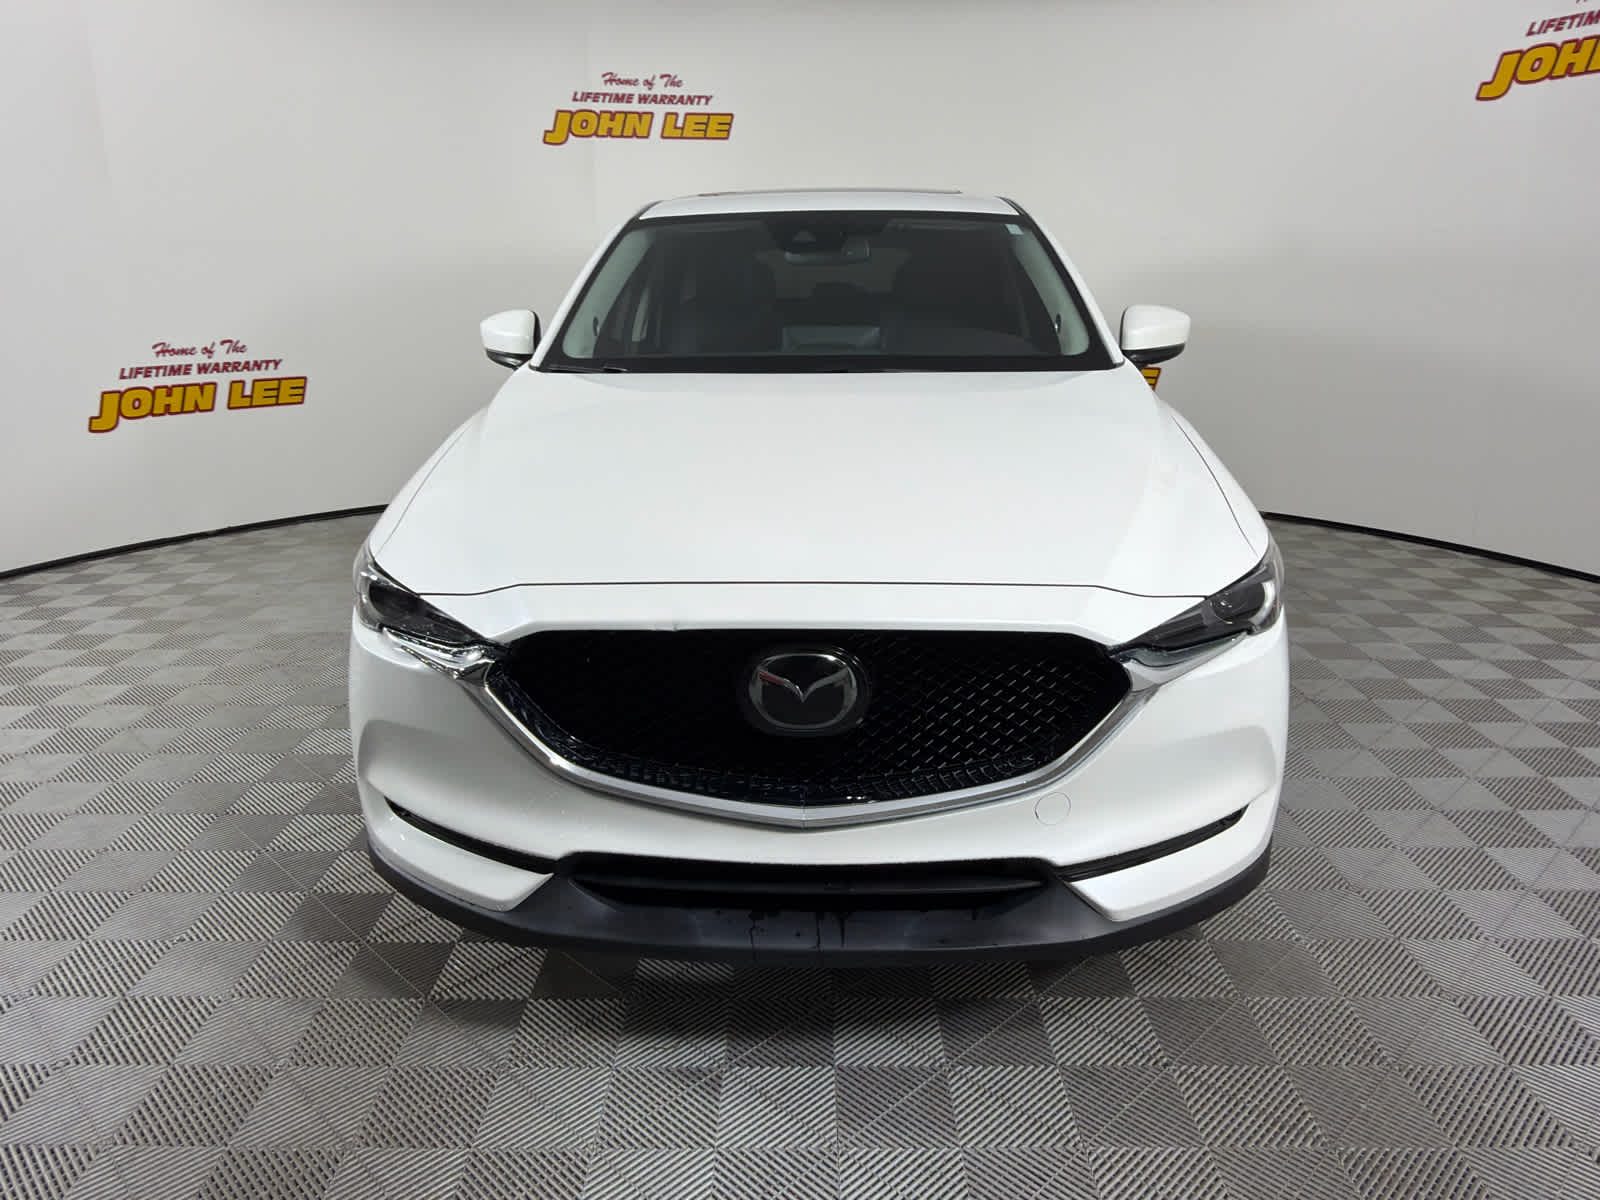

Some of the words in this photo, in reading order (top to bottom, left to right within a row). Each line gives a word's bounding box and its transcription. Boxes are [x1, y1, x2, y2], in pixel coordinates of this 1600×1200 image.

[601, 72, 640, 87] Home
[643, 75, 655, 90] of
[660, 74, 682, 88] The
[572, 92, 634, 104] LIFETIME
[638, 94, 713, 105] WARRANTY
[543, 109, 654, 145] JOHN
[661, 112, 734, 140] LEE
[152, 342, 197, 357] Home
[201, 342, 215, 358] of
[220, 339, 248, 354] The
[119, 363, 193, 380] LIFETIME
[196, 358, 282, 375] WARRANTY
[88, 382, 217, 433] JOHN
[227, 376, 307, 410] LEE
